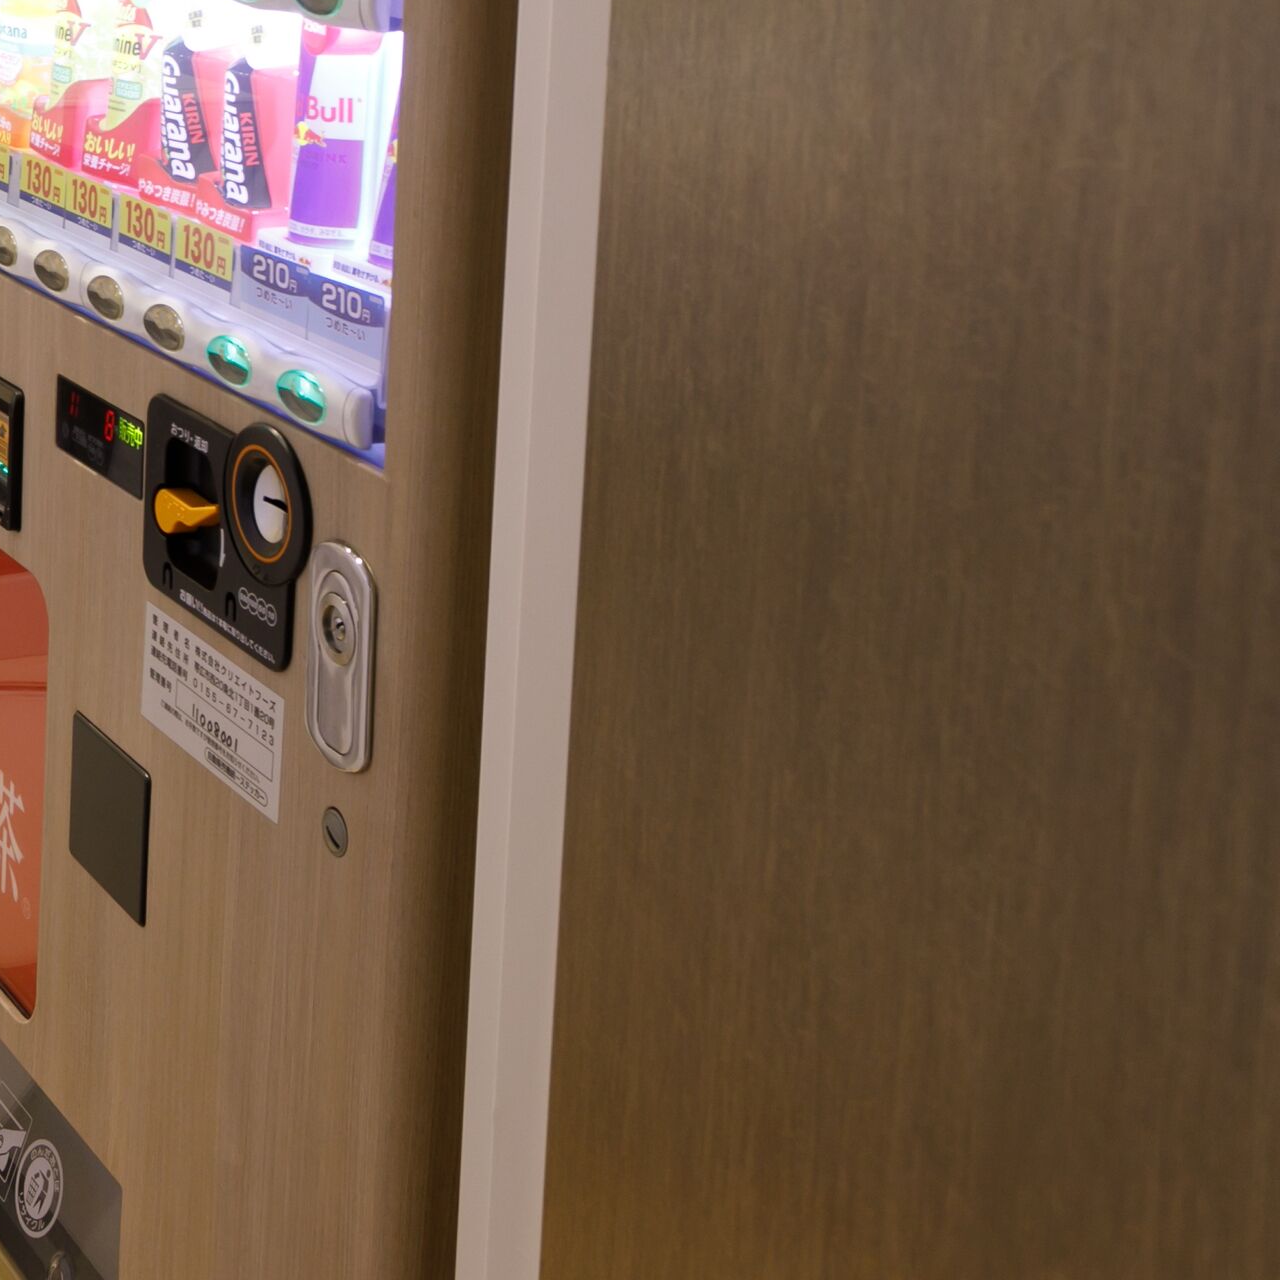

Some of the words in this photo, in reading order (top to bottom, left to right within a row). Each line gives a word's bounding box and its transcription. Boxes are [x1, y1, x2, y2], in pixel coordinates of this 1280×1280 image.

[162, 55, 196, 180] Guarana
[183, 93, 204, 144] KIRIN
[223, 70, 249, 204] Guarana
[240, 112, 259, 166] KIRIN
[27, 160, 60, 203] 130円
[72, 179, 107, 224] 130円
[126, 200, 165, 249] 130円
[184, 224, 226, 277] 130円
[253, 254, 297, 293] 210円
[322, 282, 371, 323] 210円
